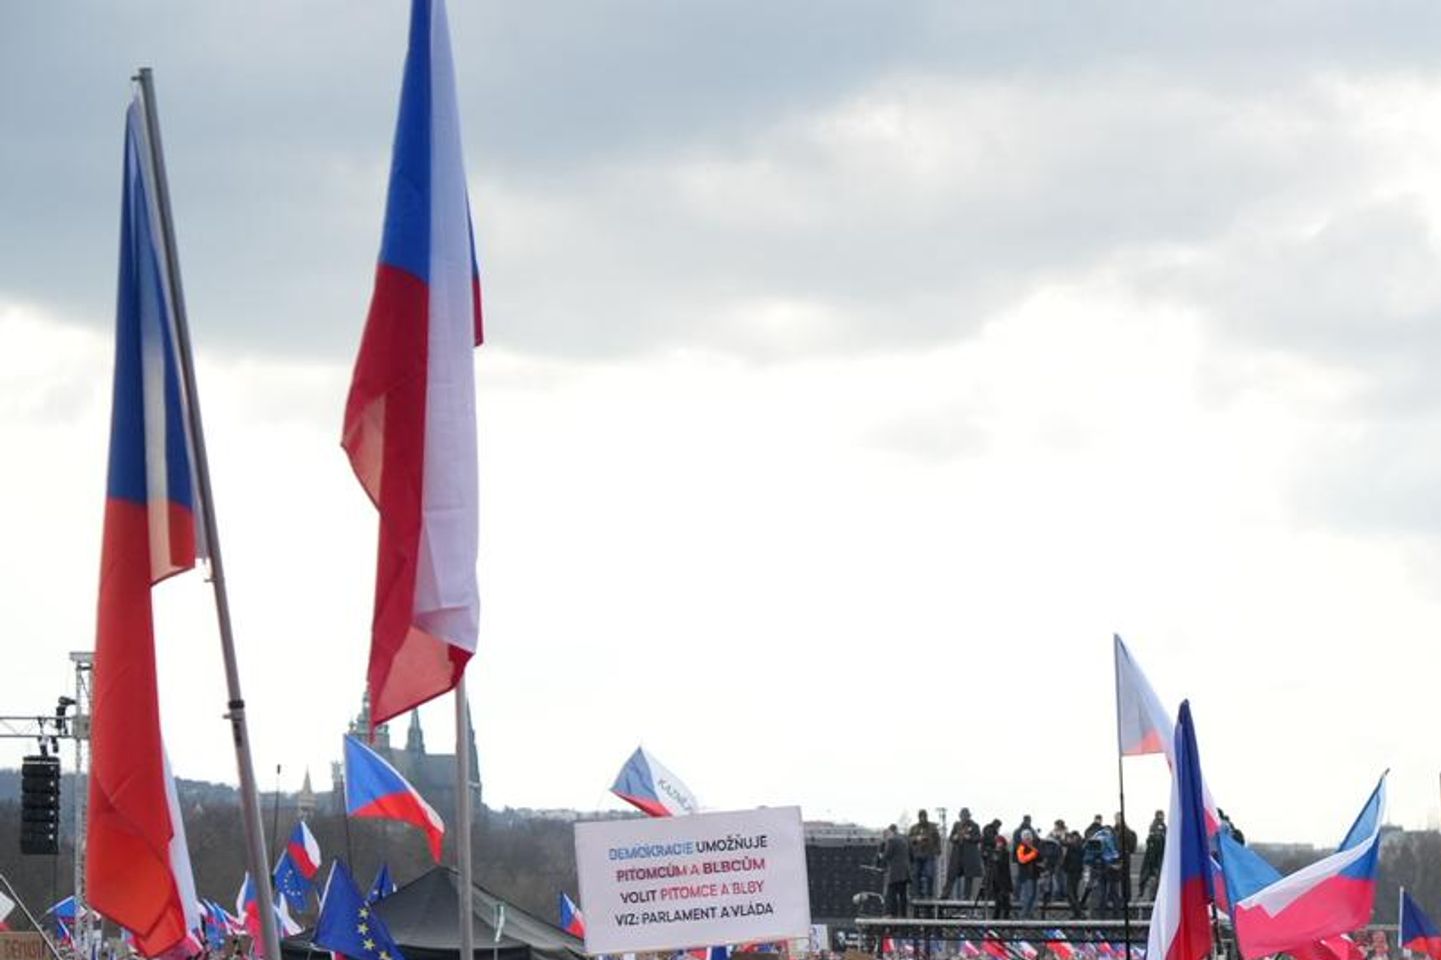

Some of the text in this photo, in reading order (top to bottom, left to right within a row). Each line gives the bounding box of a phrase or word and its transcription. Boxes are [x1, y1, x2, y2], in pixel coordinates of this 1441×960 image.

[609, 834, 768, 860] DEMOKRACIE UMOŽŇUJE
[690, 864, 700, 876] A
[620, 880, 764, 904] VOLIT PITOMCE A BLBY
[615, 914, 640, 927] VIZ:
[642, 908, 717, 924] PARLAMENT
[720, 907, 731, 918] A
